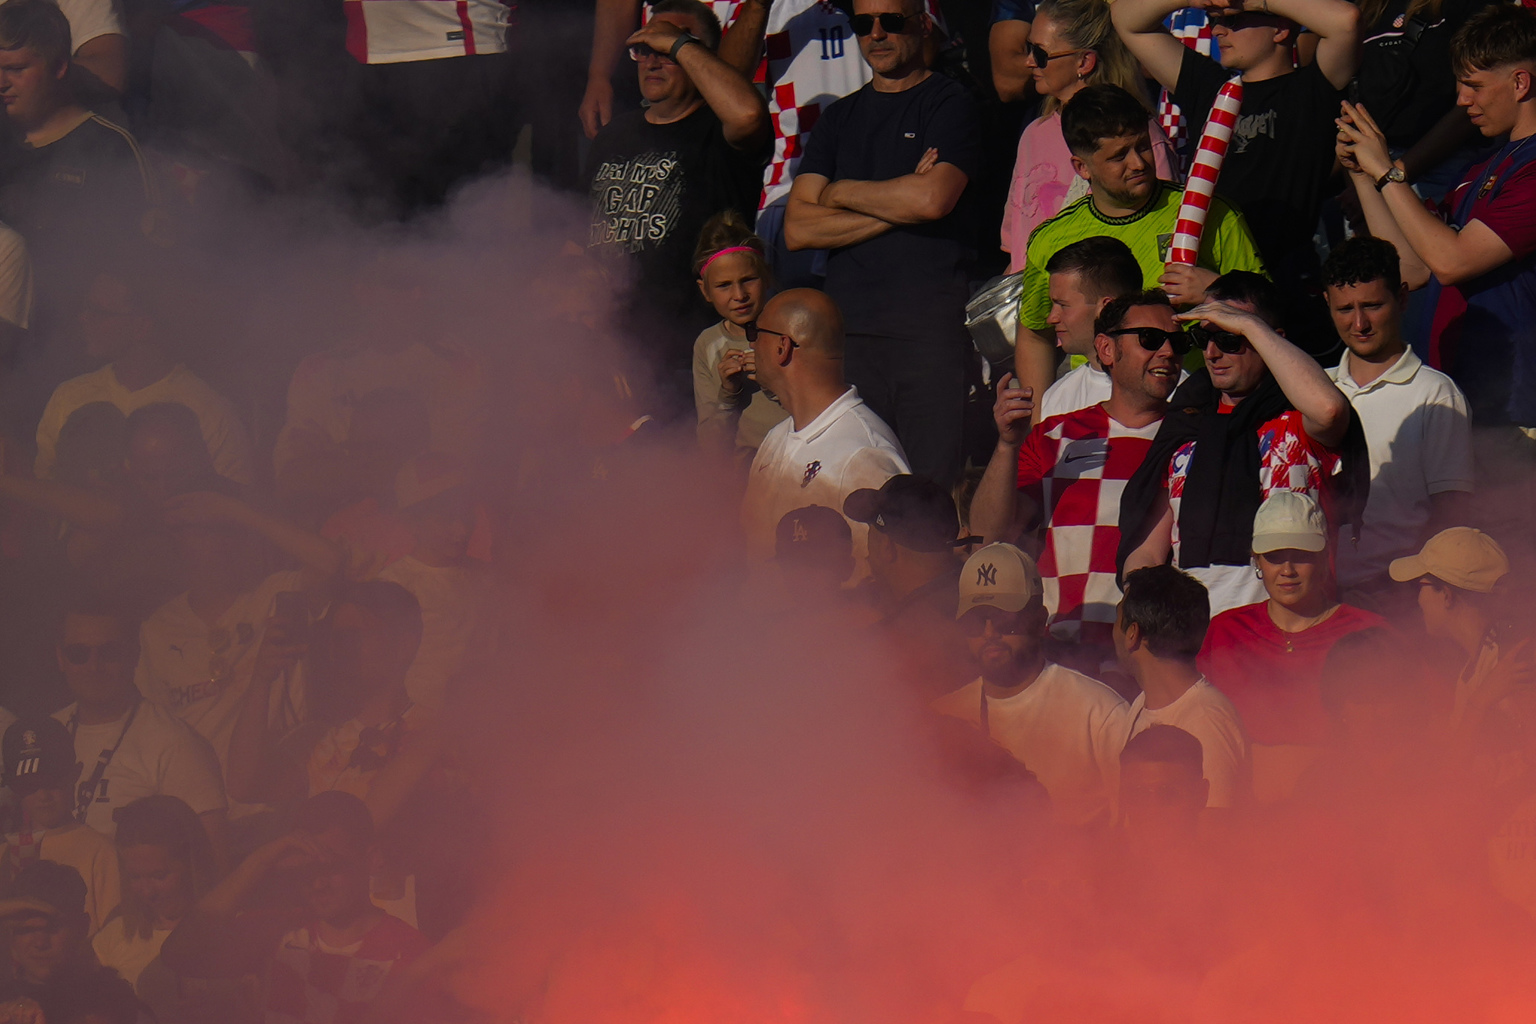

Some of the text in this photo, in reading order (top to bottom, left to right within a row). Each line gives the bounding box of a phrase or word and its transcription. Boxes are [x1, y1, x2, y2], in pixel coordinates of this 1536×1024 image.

[819, 25, 844, 60] 10
[605, 185, 661, 214] GAR
[792, 519, 808, 542] LA
[976, 562, 998, 587] NY
